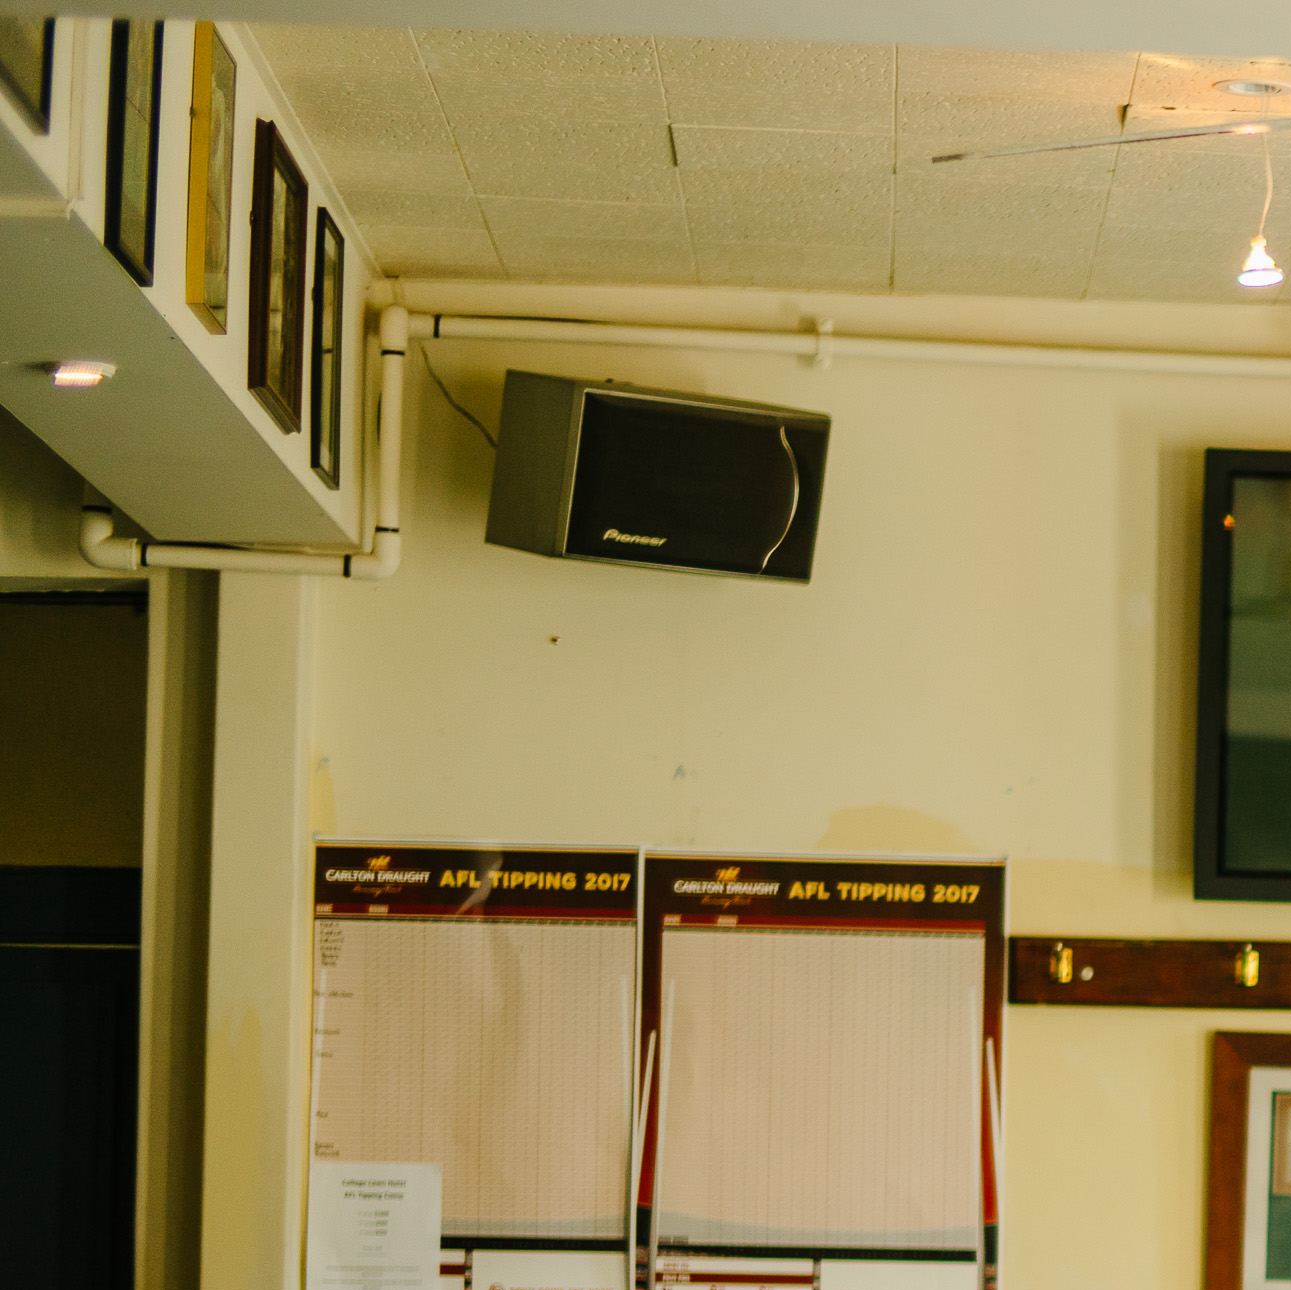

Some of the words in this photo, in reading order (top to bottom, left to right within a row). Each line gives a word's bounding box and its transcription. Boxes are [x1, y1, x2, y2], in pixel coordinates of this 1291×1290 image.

[603, 528, 668, 547] Pioneer
[325, 869, 375, 883] CARLTON
[377, 870, 431, 884] DRAUGHT
[439, 869, 482, 889] AFL
[489, 870, 577, 891] TIPPING
[584, 872, 633, 892] 2017
[673, 880, 724, 895] CARLTON
[726, 882, 780, 896] DRAUGHT
[789, 881, 830, 900] AFL
[837, 882, 926, 902] TIPPING
[932, 884, 980, 904] 2017
